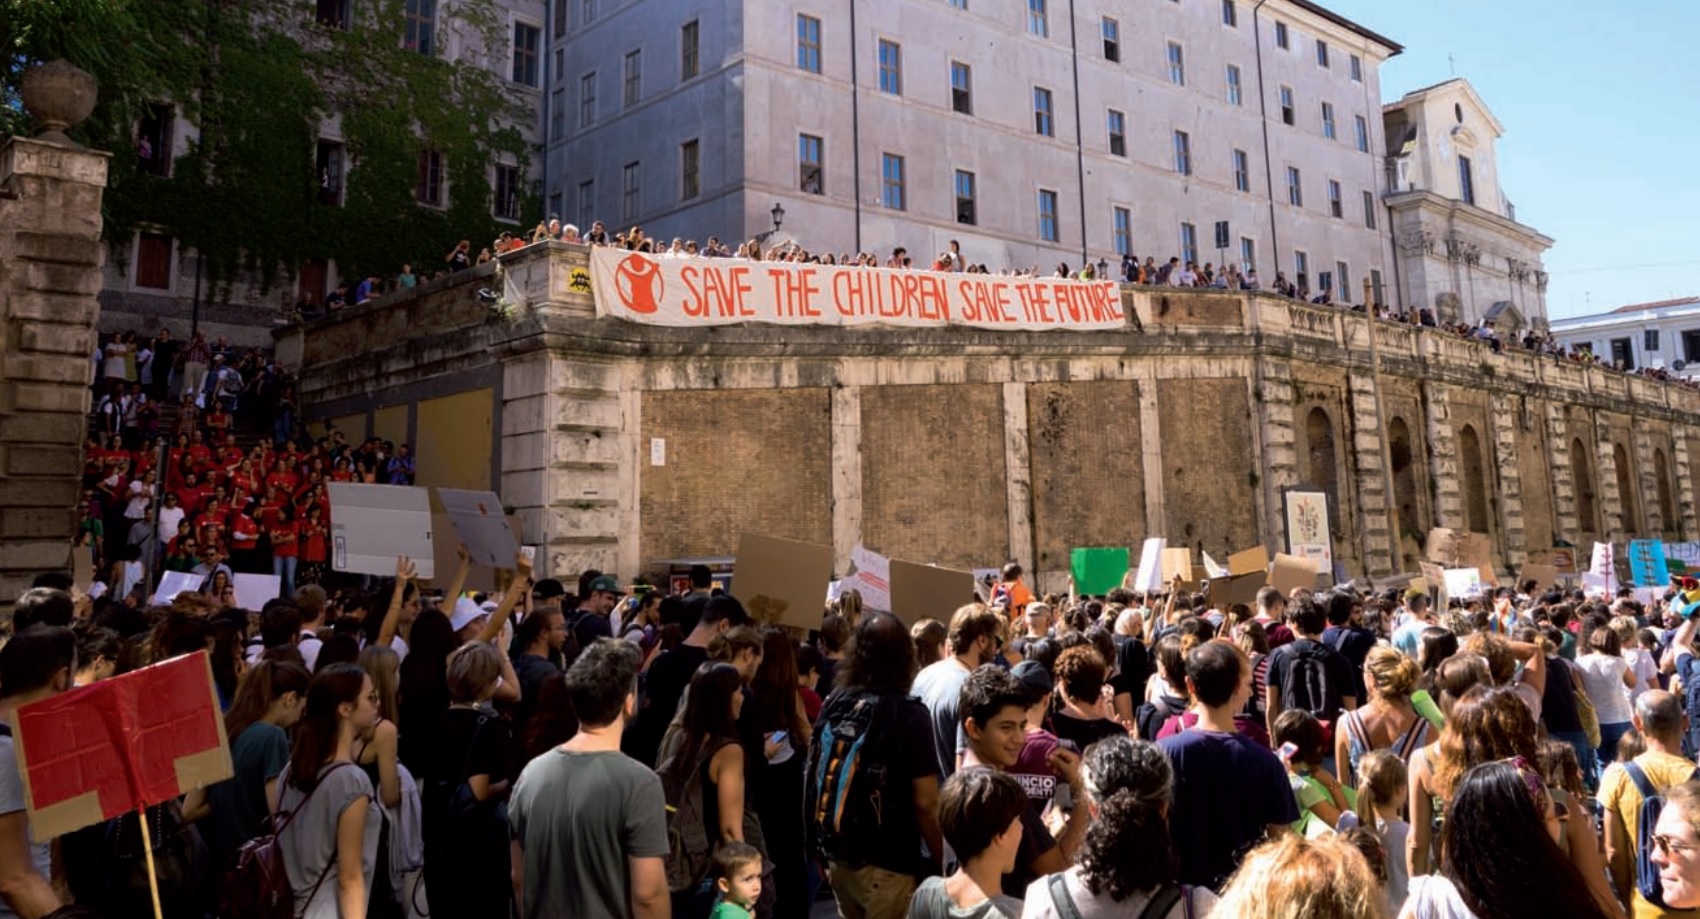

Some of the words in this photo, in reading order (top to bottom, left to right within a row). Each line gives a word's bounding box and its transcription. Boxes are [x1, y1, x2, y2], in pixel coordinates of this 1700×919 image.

[680, 266, 755, 317] SAVE
[768, 269, 821, 317] THE
[832, 271, 951, 321] CHILDREN
[958, 280, 1017, 322] SAVE
[1015, 284, 1055, 322] THE
[1053, 282, 1125, 322] FUTURE
